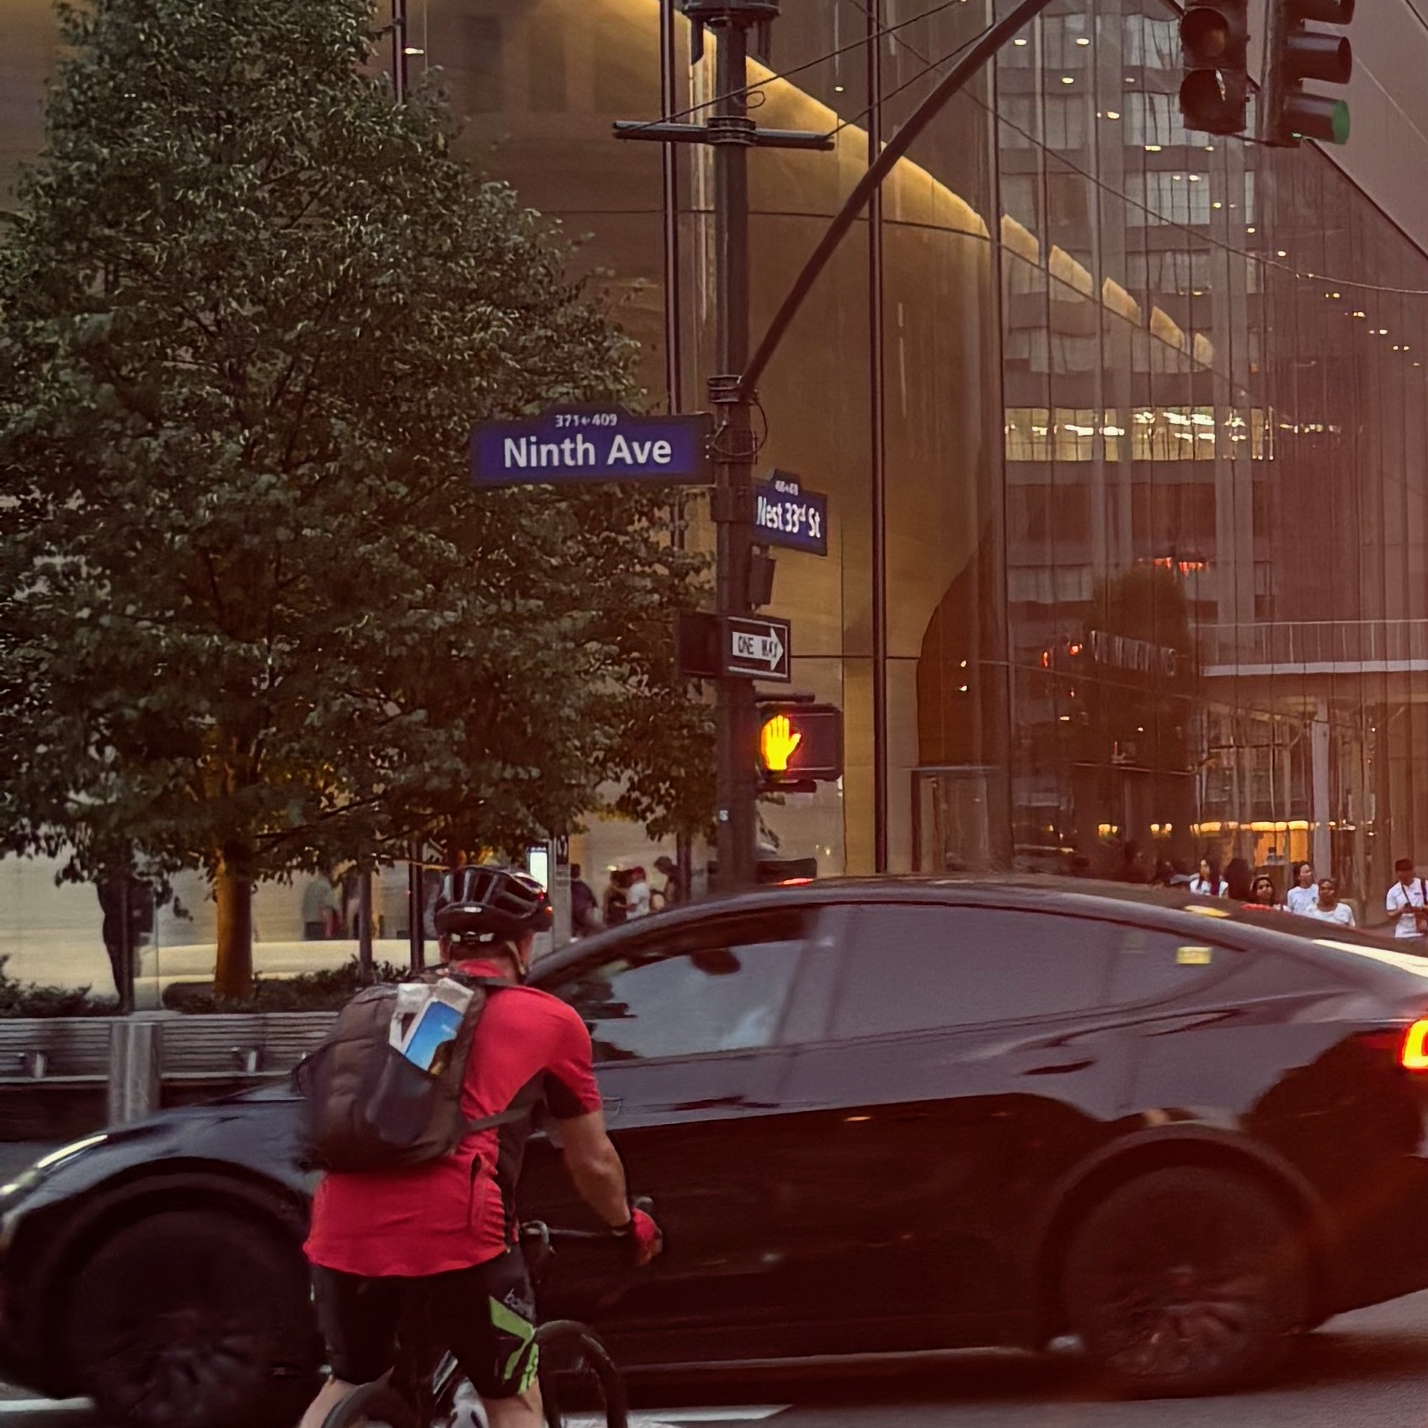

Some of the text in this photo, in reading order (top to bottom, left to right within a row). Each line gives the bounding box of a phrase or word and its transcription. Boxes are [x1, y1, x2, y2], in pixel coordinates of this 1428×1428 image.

[504, 433, 672, 467] Ninth Ave
[808, 507, 821, 539] St
[737, 635, 754, 655] ONE
